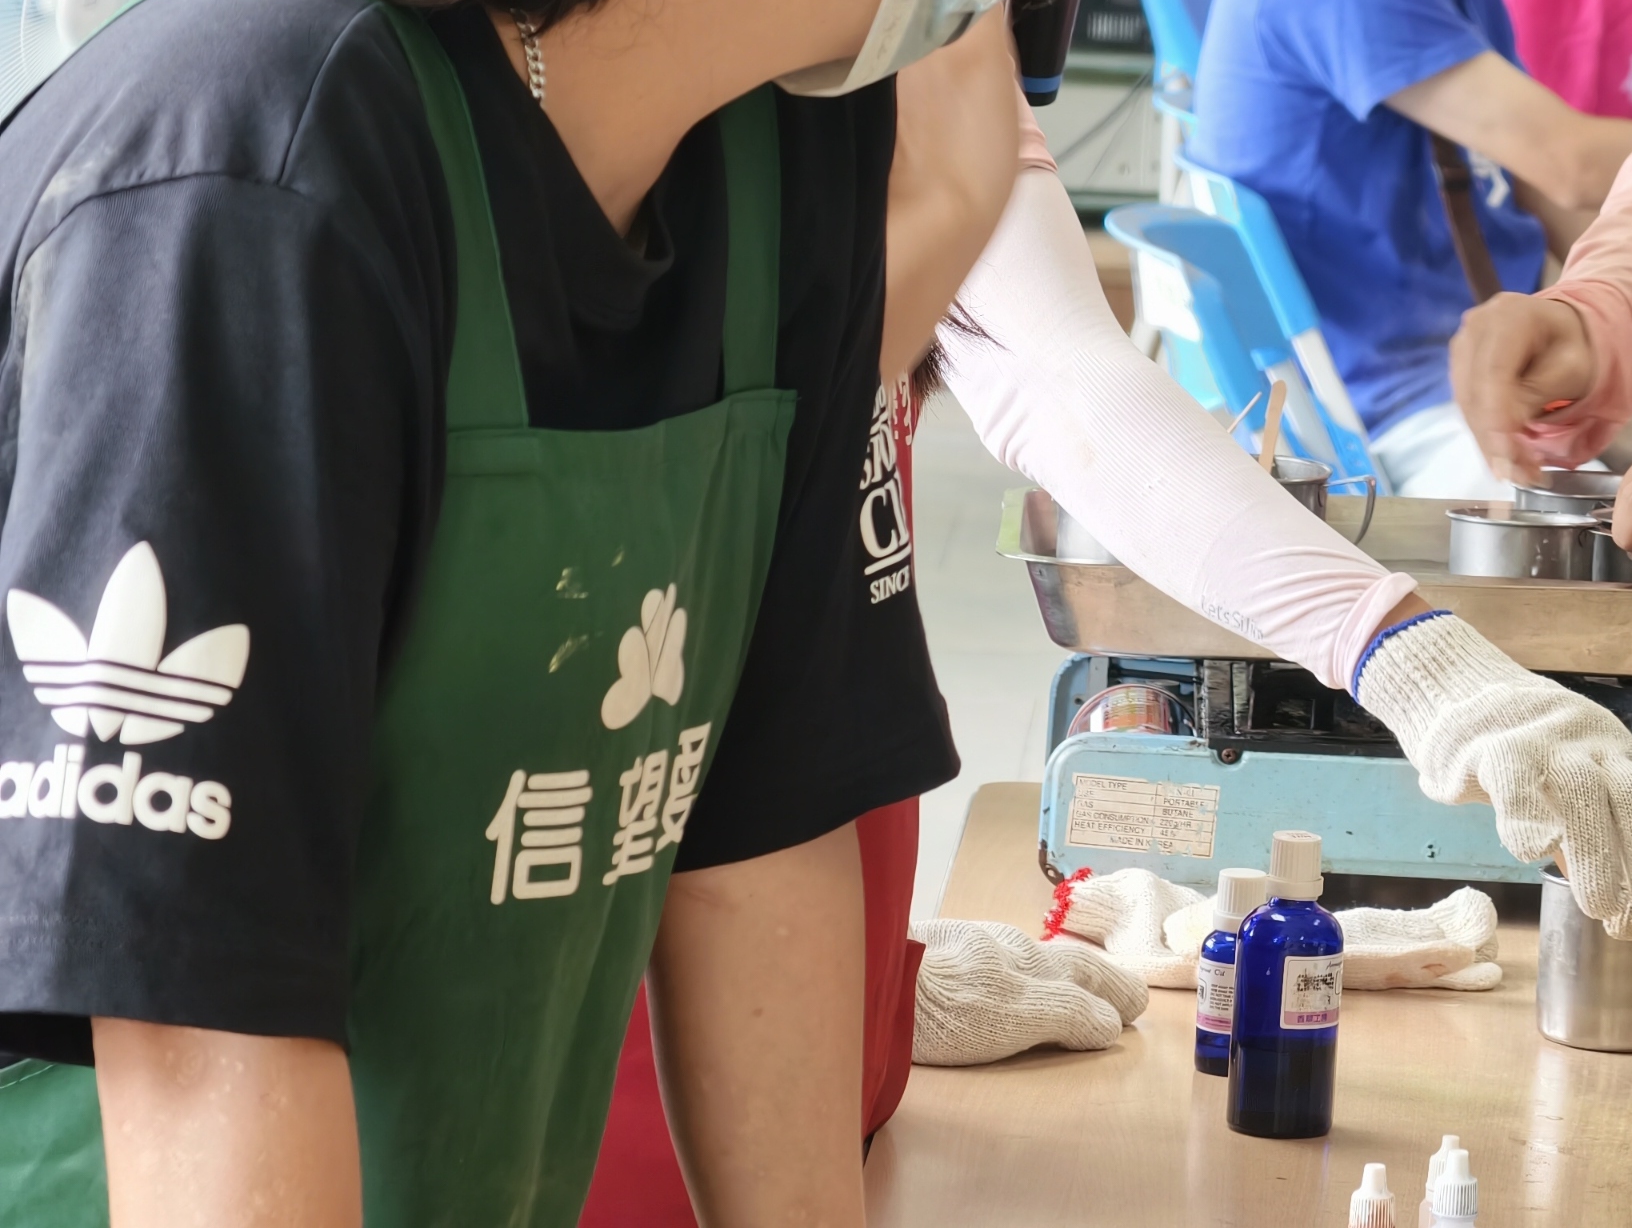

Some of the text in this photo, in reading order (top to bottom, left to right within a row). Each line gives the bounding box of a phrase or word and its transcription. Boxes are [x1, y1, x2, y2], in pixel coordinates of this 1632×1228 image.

[0, 743, 232, 840] adidas
[1108, 781, 1128, 790] TYPE
[1163, 797, 1206, 808] PORTABLE
[1162, 808, 1194, 818] BUTANE
[1074, 820, 1095, 830] HEAT
[1097, 823, 1145, 834] EFFICIENCY
[1109, 835, 1174, 849] MADE IN KREA
